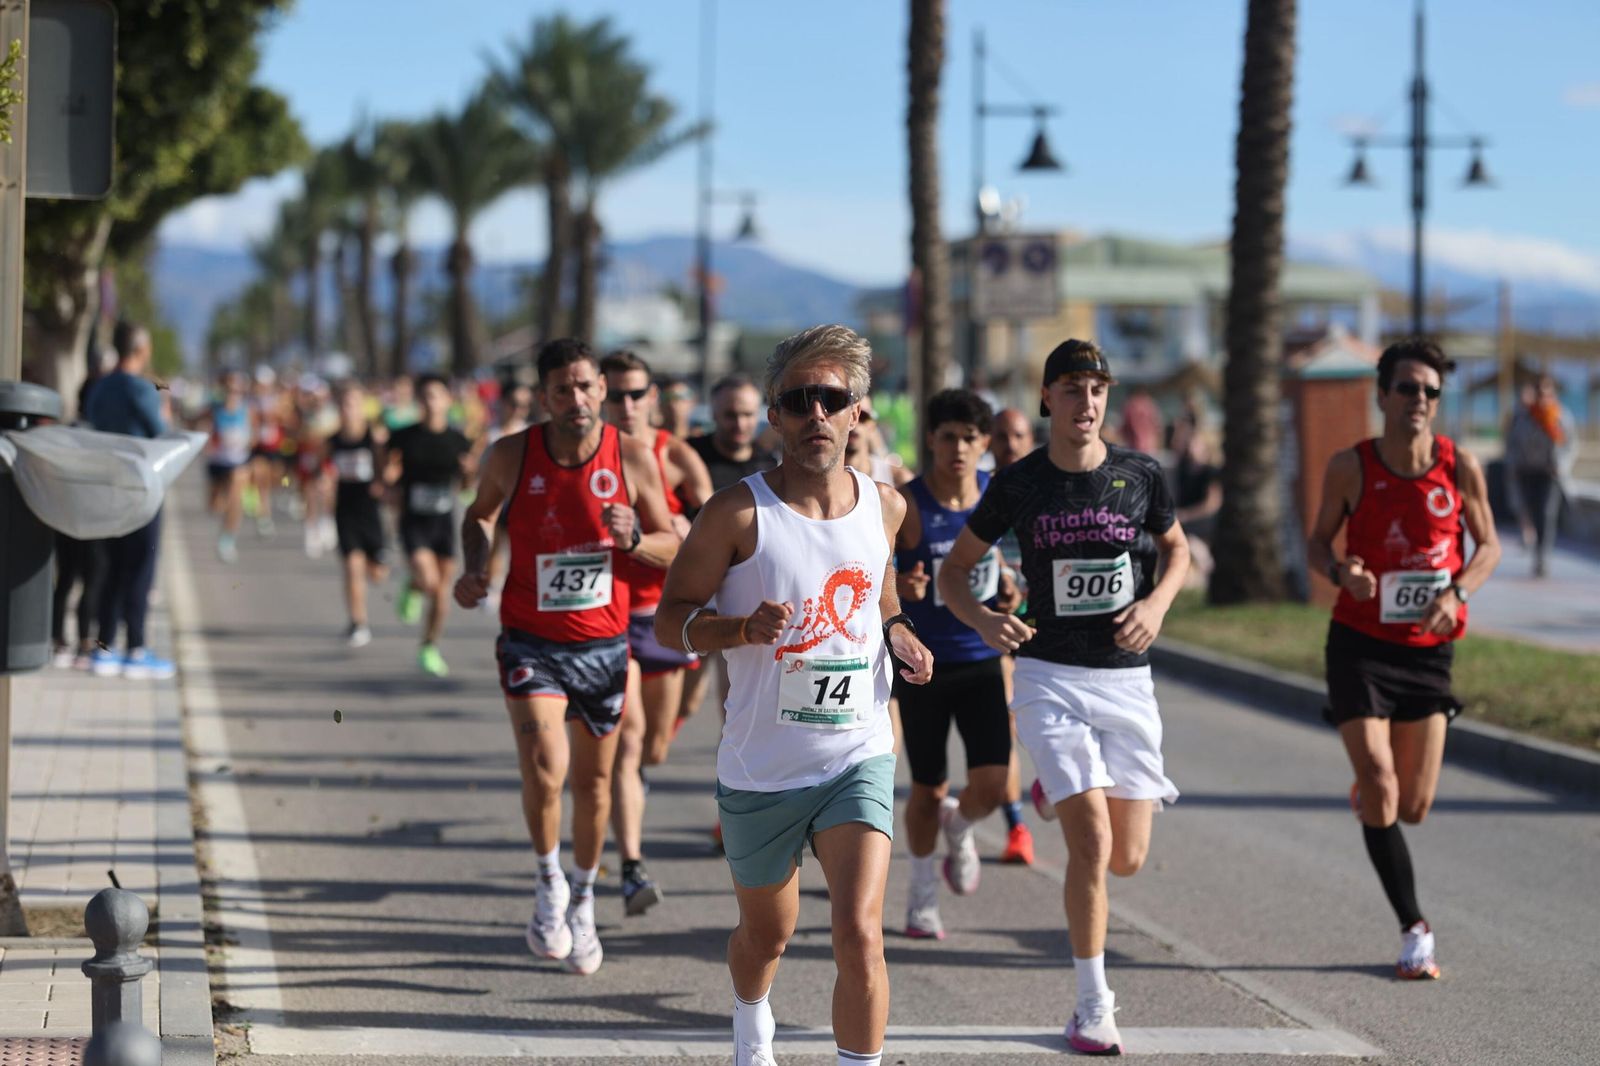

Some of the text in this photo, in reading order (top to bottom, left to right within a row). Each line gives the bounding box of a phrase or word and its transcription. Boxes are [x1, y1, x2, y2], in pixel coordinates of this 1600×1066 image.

[1037, 506, 1129, 532] Triatlón
[1048, 523, 1136, 549] Posadas
[549, 566, 604, 593] 437
[1066, 571, 1122, 599] 906
[813, 675, 852, 706] 14
